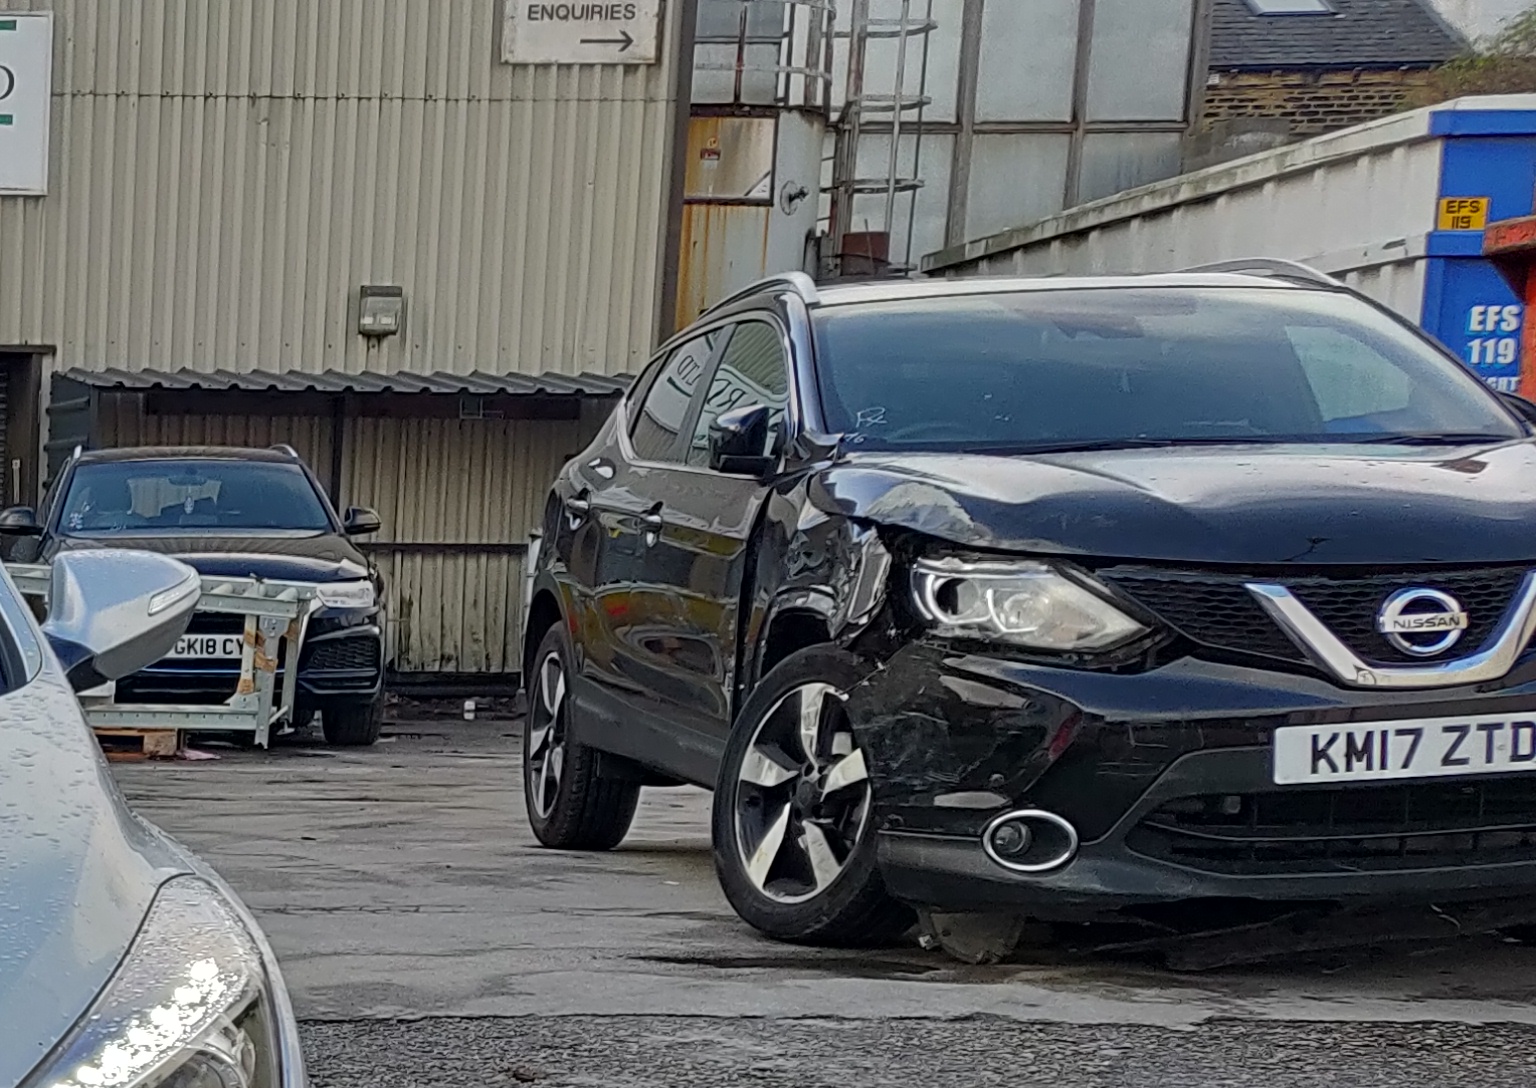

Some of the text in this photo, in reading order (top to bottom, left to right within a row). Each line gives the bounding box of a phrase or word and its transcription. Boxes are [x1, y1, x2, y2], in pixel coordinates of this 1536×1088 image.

[528, 4, 636, 21] ENQUIRIES
[1446, 200, 1480, 214] EFS
[1451, 216, 1471, 230] 119
[1468, 305, 1521, 332] EFS
[1467, 337, 1516, 364] 119
[1392, 615, 1461, 629] NISSAN
[174, 638, 244, 655] GK18 CY
[1310, 720, 1536, 775] KM17 ZTD
